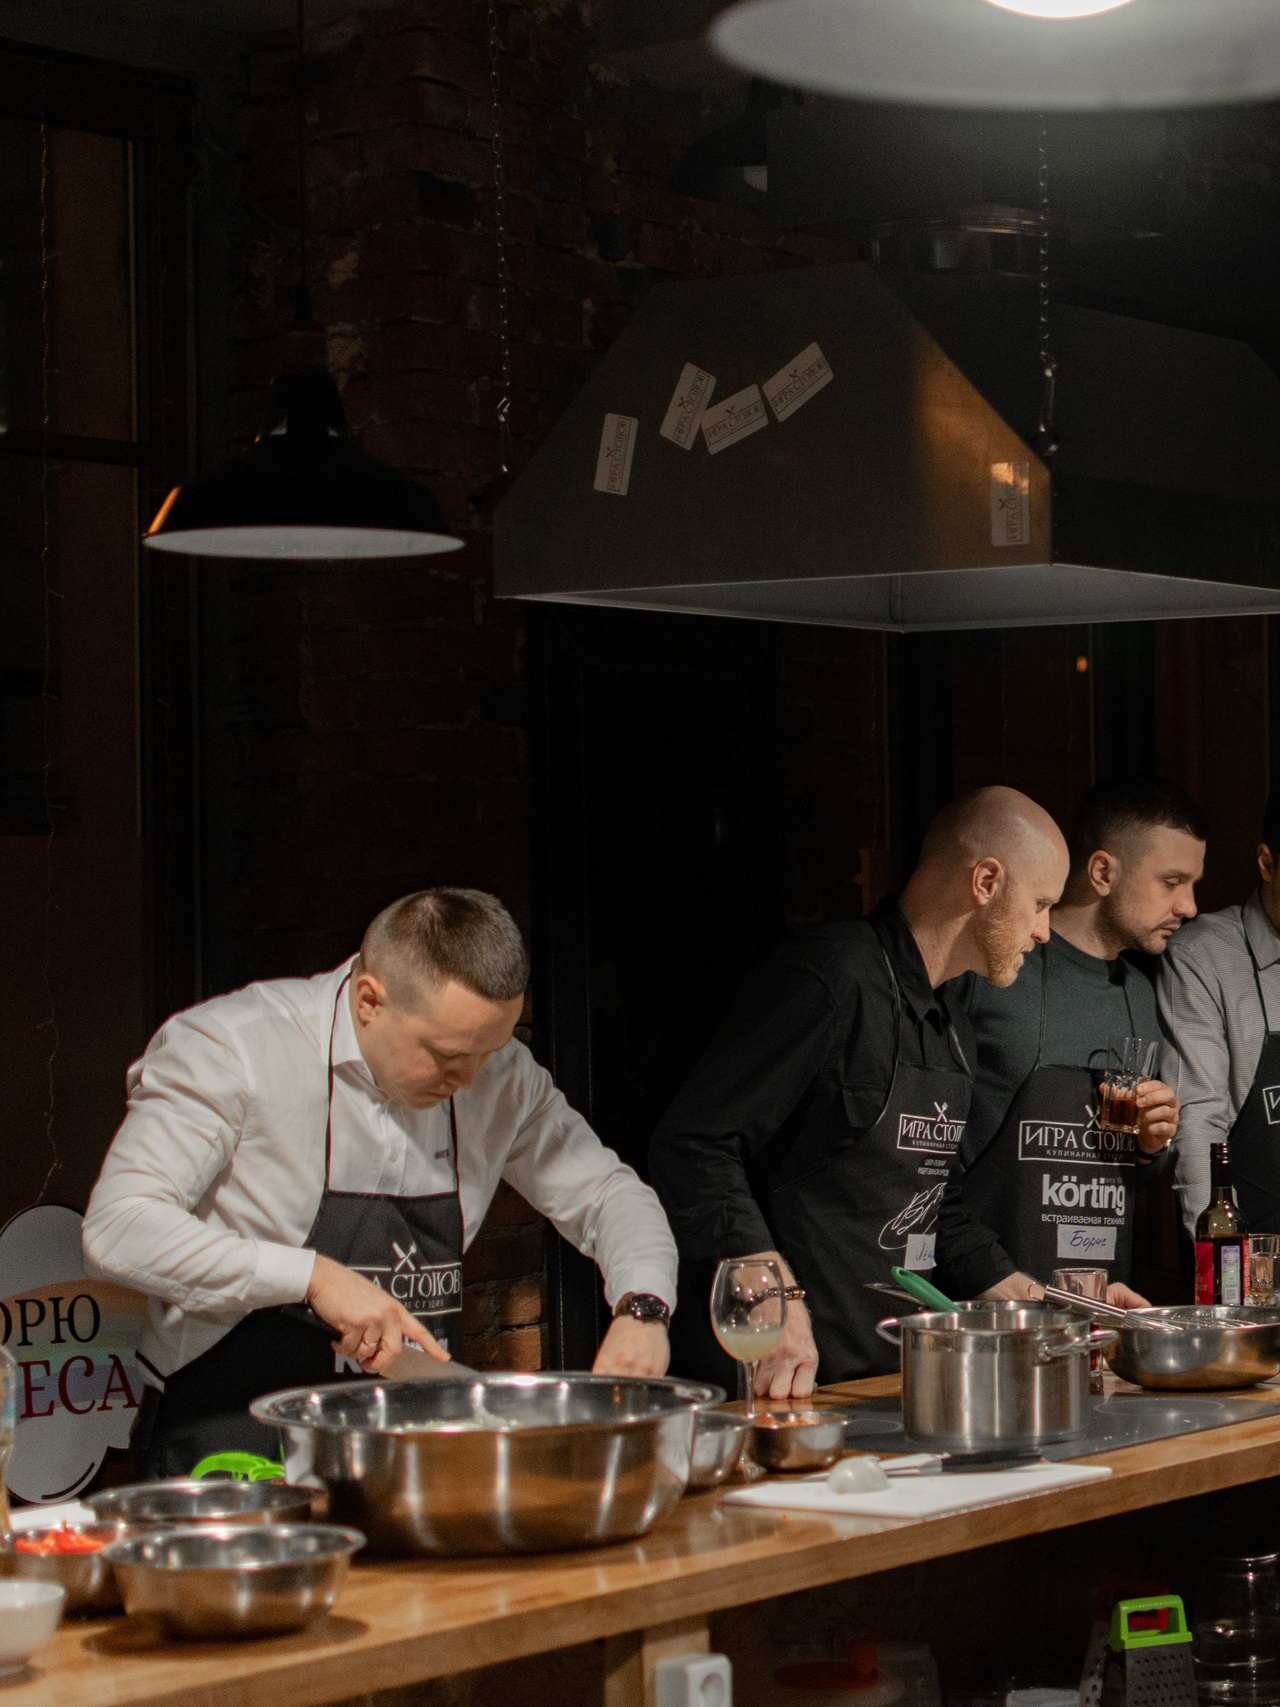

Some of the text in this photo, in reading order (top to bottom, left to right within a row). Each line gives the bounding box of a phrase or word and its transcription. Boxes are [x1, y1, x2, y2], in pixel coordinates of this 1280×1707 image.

[902, 1119, 931, 1140] ИГРА
[1025, 1125, 1078, 1149] ИГРА
[1042, 1174, 1126, 1216] körting
[1041, 1213, 1102, 1225] встраиваемая
[1070, 1230, 1107, 1252] Борис
